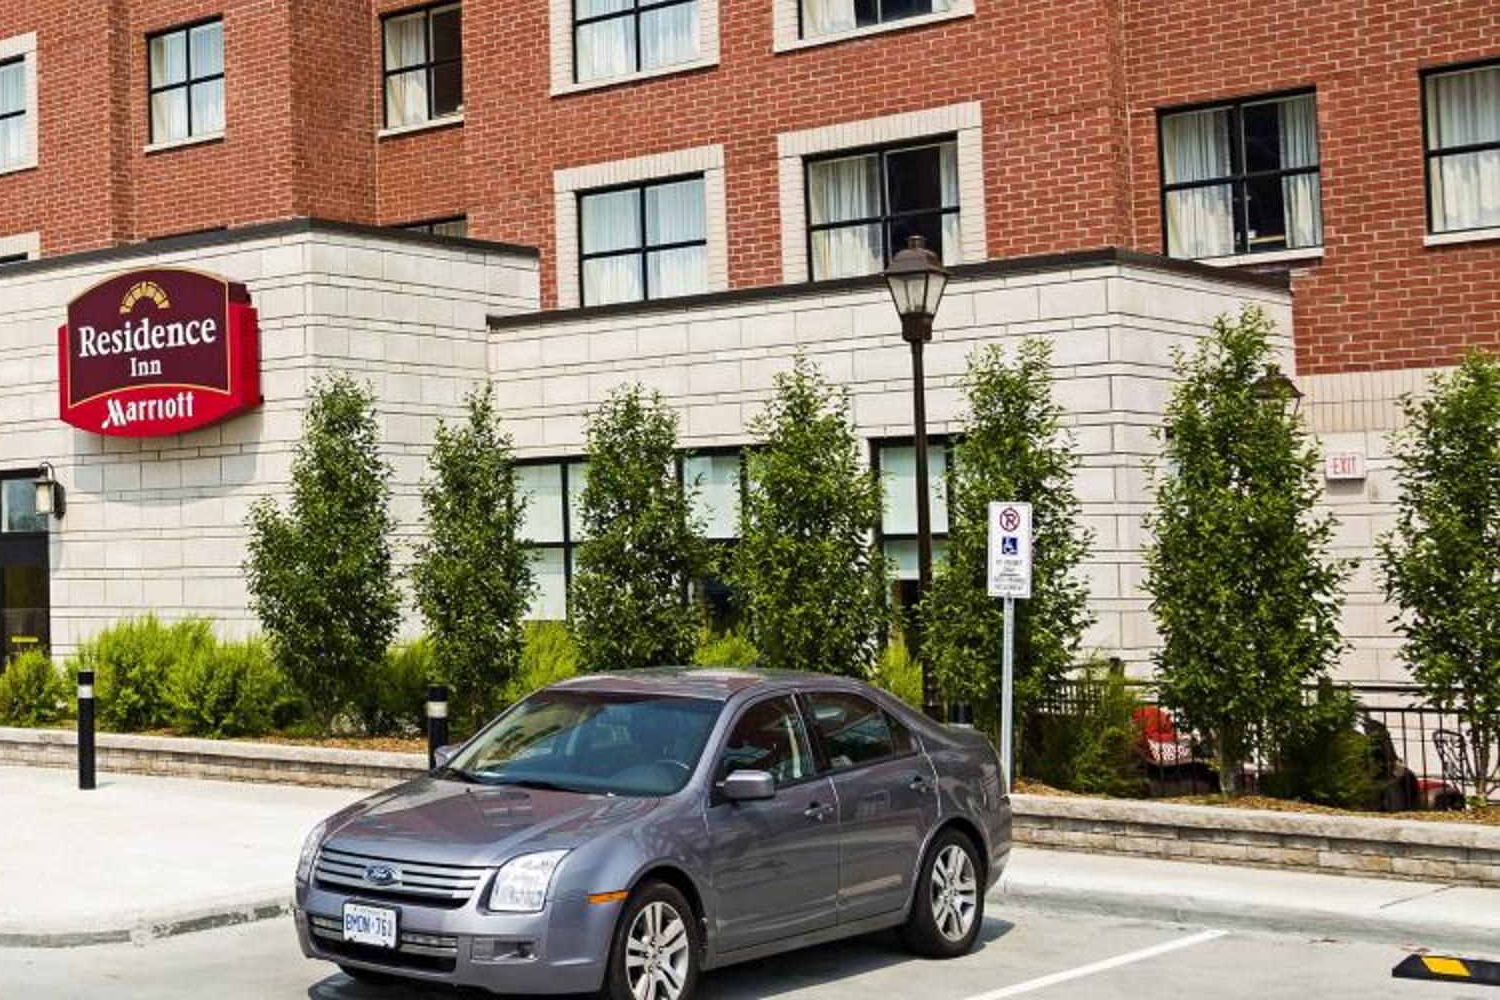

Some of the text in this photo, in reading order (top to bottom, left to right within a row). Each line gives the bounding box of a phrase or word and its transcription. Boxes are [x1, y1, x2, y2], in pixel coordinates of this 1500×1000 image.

[78, 316, 217, 358] Residence
[130, 357, 163, 377] Inn
[101, 391, 194, 430] Marriott
[1332, 455, 1357, 475] EXIT
